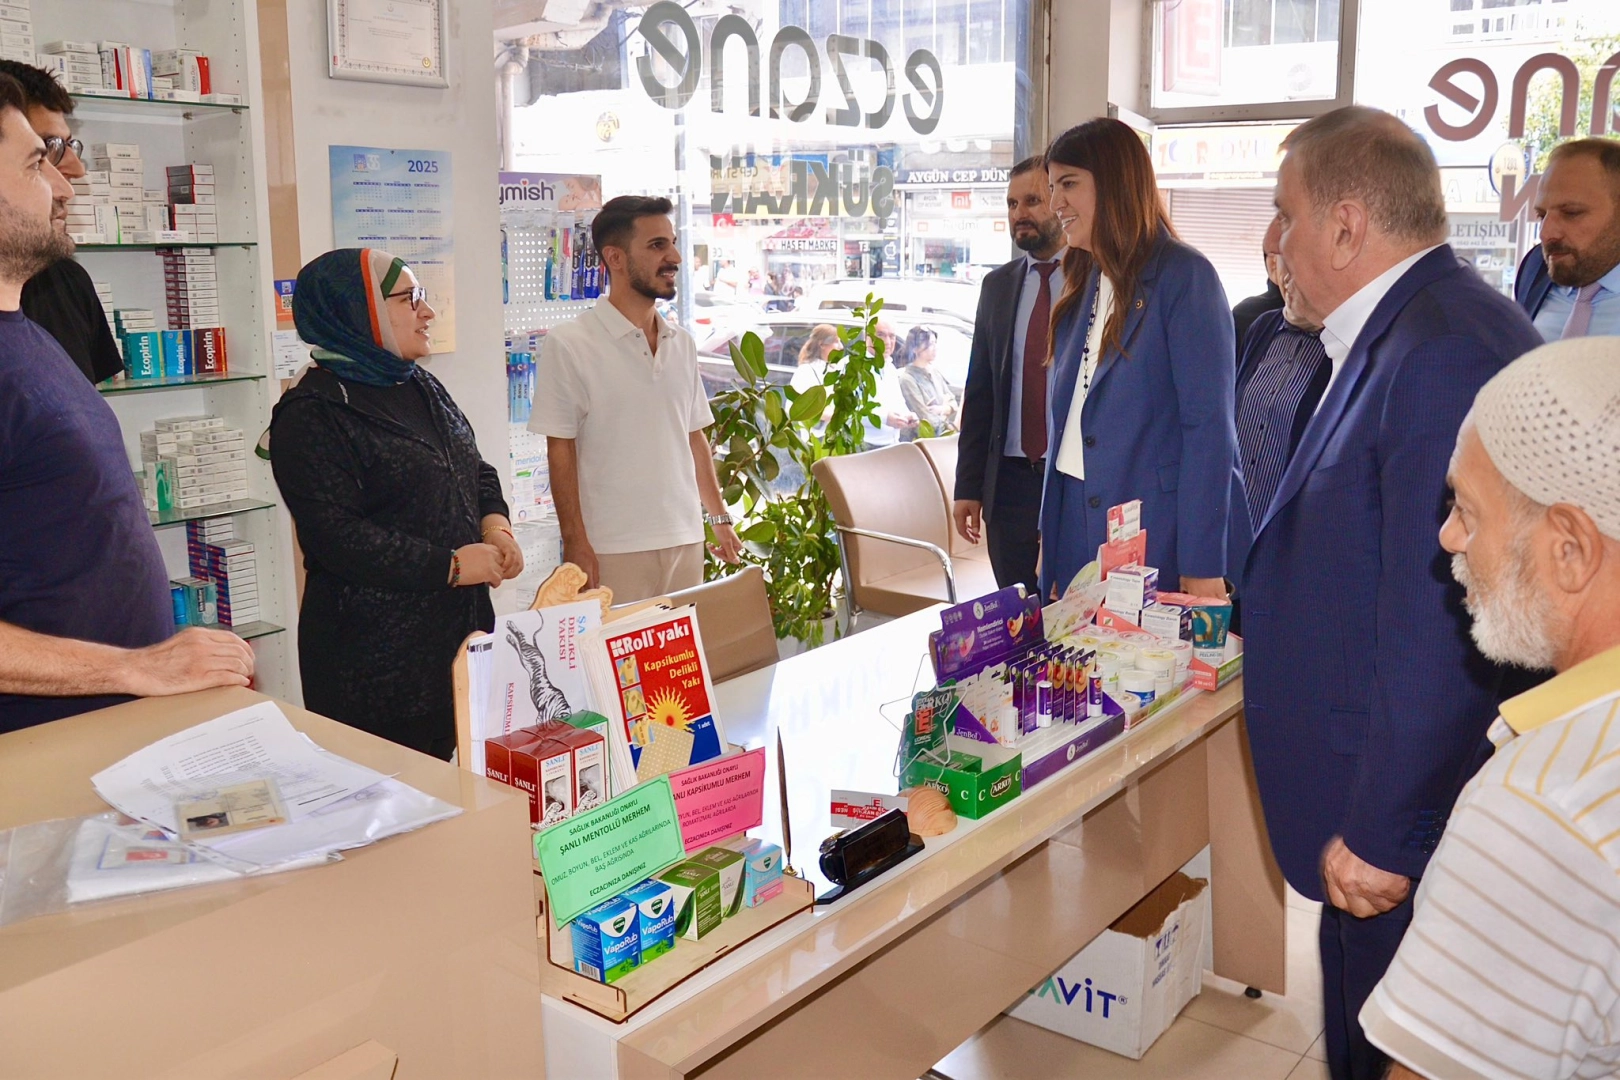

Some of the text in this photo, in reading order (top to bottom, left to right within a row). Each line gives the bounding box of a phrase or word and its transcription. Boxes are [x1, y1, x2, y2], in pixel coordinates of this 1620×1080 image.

[407, 159, 439, 174] 2025
[907, 168, 949, 183] AYGÜN
[952, 169, 978, 182] CEP
[781, 240, 796, 250] HAS
[797, 240, 806, 250] ET
[138, 335, 153, 376] Ecopirin
[176, 344, 186, 375] Ecopirin
[202, 331, 216, 370] Ecopirin
[568, 616, 577, 670] DELİKLİ
[657, 621, 690, 649] yakı
[643, 649, 695, 672] Kapsikumlu
[669, 661, 698, 679] Delikli
[681, 676, 701, 689] Yakı
[956, 728, 978, 740] JenBol
[486, 767, 509, 783] ŞANLI
[514, 777, 537, 792] ŞANLI
[681, 764, 739, 787] SAĞLIK BAKANLIĞI ONAYLI
[686, 778, 725, 797] KAPSİKUMLU
[725, 770, 751, 785] MERHEM
[991, 778, 1012, 793] ARKO
[702, 802, 717, 812] EKLEM
[723, 798, 732, 806] KAS
[712, 804, 736, 817] AĞRILARDA
[569, 799, 638, 836] SAĞLIK BAKANLIĞI ONAYLI
[559, 804, 651, 856] ŞANLI MENTOLLÜ MERHEM
[684, 822, 733, 845] ECZACINIZA DANIŞINIZ
[590, 855, 603, 865] BEL,
[602, 845, 621, 859] EKLEM
[620, 840, 629, 849] VE
[628, 835, 639, 845] KAS
[638, 819, 671, 839] AĞRILARINDA
[594, 848, 635, 873] BAŞ AĞRISINDA
[589, 861, 647, 897] ECZACINIZA DANIŞINIZ
[586, 897, 621, 916] VapoRub
[576, 918, 598, 933] VapoRub
[642, 914, 674, 936] VapoRub
[604, 933, 638, 955] VapoRub
